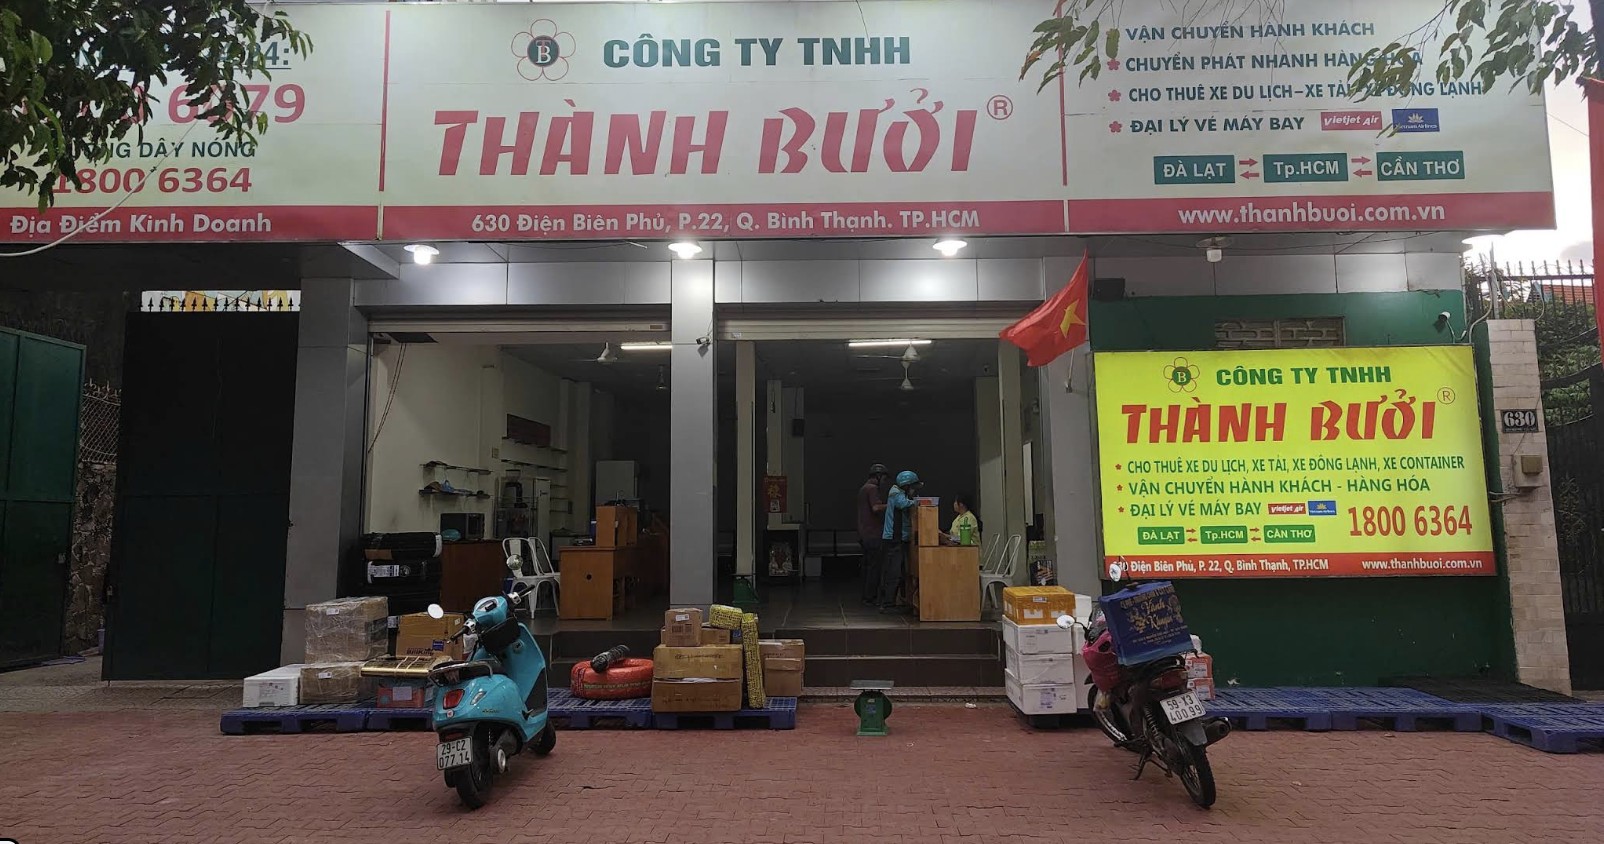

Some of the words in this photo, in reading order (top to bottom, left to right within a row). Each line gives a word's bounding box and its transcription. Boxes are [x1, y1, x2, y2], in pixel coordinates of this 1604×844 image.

[1125, 25, 1165, 43] VẬN
[1171, 20, 1244, 39] CHUYỂN
[1250, 22, 1305, 38] HÀNH
[1311, 19, 1375, 36] KHÁCH
[603, 33, 721, 68] CÔNG
[734, 37, 783, 66] TY
[797, 36, 910, 65] TNHH
[1125, 51, 1195, 72] CHUYỂN
[1201, 52, 1245, 70] PHÁT
[1251, 53, 1318, 69] NHANH
[1128, 87, 1162, 101] CHO
[1165, 83, 1205, 101] THUÊ
[1209, 86, 1228, 100] XE
[1232, 85, 1254, 100] DU
[1439, 82, 1482, 99] LẠNH
[433, 99, 729, 176] THÀNH
[757, 87, 978, 174] BƯỞI
[1129, 119, 1163, 135] ĐẠI
[1169, 116, 1189, 132] LÝ
[1194, 116, 1217, 132] VÉ
[1223, 114, 1264, 131] MÁY
[1269, 117, 1305, 130] BAY
[1362, 115, 1379, 127] Air
[139, 137, 184, 158] DÂY
[191, 137, 256, 158] NÓNG
[1163, 160, 1187, 178] ĐÀ
[1193, 162, 1227, 180] LẠT
[1273, 160, 1339, 179] Tp.HCM
[1380, 156, 1418, 176] CẦN
[1423, 159, 1461, 176] THƠ
[53, 167, 146, 194] 1800
[158, 167, 252, 194] 6364
[471, 213, 511, 232] 630
[516, 213, 565, 236] Điện
[573, 213, 619, 231] Biên
[626, 213, 671, 233] Phủ,
[678, 212, 729, 233] P.22,
[736, 212, 760, 232] Q.
[767, 211, 814, 230] Bình
[899, 209, 980, 229] TP.HCM
[1178, 201, 1446, 224] www.thanhbuoi.com.vn
[10, 215, 51, 238] Địa
[59, 212, 121, 235] Điểm
[129, 213, 184, 234] Kinh
[192, 212, 272, 233] Doanh
[1215, 365, 1283, 386] CÔNG
[1290, 367, 1318, 384] TY
[1326, 365, 1392, 384] TNHH
[1121, 397, 1287, 444] THÀNH
[1310, 388, 1436, 441] BƯỞI
[1503, 411, 1536, 427] 630
[1127, 460, 1151, 474] CHO
[1153, 456, 1183, 473] THUÊ
[1186, 459, 1199, 473] XE
[1202, 459, 1218, 473] DU
[1221, 459, 1249, 475] LỊCH,
[1252, 458, 1266, 472] XE
[1292, 458, 1307, 471] XE
[1308, 454, 1343, 471] ĐÔNG
[1346, 457, 1380, 473] LẠNH,
[1383, 457, 1398, 470] XE
[1400, 455, 1465, 470] CONTAINER
[1128, 478, 1160, 498] VẬN
[1165, 476, 1225, 495] CHUYỂN
[1229, 477, 1275, 494] HÀNH
[1279, 476, 1332, 493] KHÁCH
[1347, 475, 1392, 492] HÀNG
[1396, 474, 1431, 492] HÓA
[1129, 503, 1156, 520] ĐẠI
[1160, 499, 1174, 516] LÝ
[1178, 499, 1196, 516] VÉ
[1200, 499, 1231, 516] MÁY
[1235, 502, 1262, 515] BAY
[1348, 506, 1406, 537] 1800
[1414, 505, 1473, 536] 6364
[1142, 529, 1158, 540] ĐÀ
[1160, 531, 1180, 542] LẠT
[1205, 530, 1244, 541] Tp.HCM
[1289, 529, 1313, 539] THƠ
[1131, 559, 1152, 574] Điện
[1154, 559, 1174, 572] Biên
[1199, 560, 1207, 571] P.
[1208, 559, 1222, 573] 22,
[1224, 559, 1235, 573] Q.
[1236, 558, 1258, 571] Bình
[1259, 558, 1291, 573] Thạnh,
[1292, 558, 1329, 570] TP.HCM
[1361, 557, 1483, 570] www.thanhbuoi.com.vn
[1166, 694, 1194, 711] 59-X3
[1169, 704, 1203, 722] 400.99
[441, 739, 466, 756] 29-C2
[439, 750, 470, 768] 077.14
